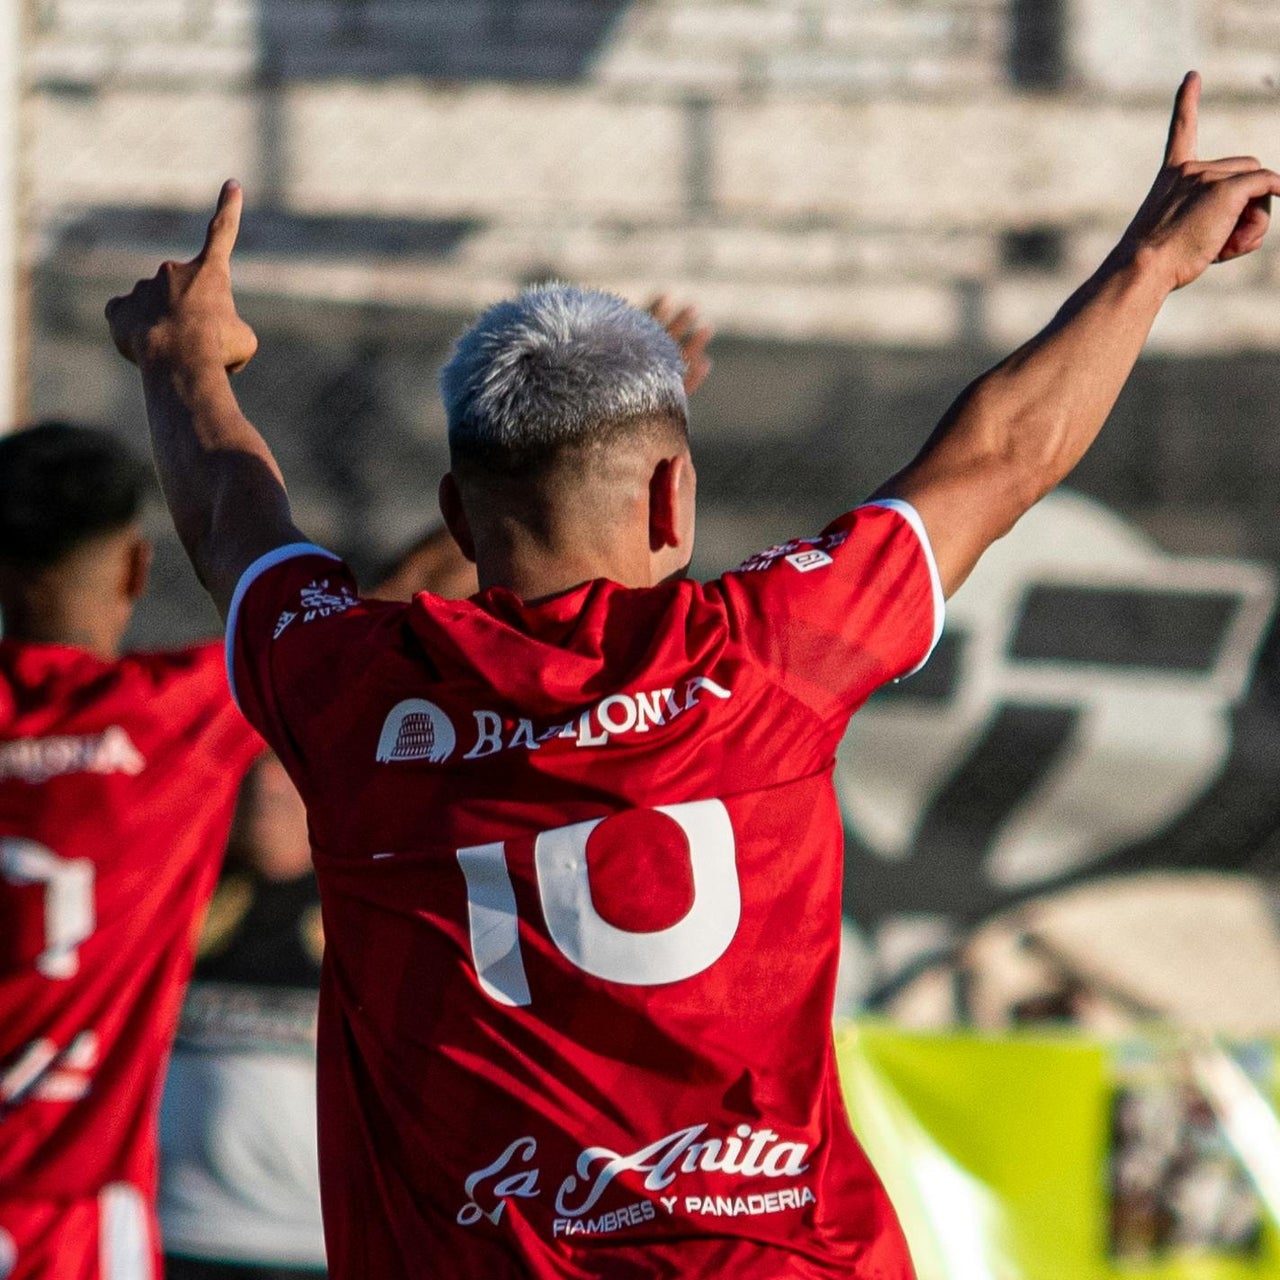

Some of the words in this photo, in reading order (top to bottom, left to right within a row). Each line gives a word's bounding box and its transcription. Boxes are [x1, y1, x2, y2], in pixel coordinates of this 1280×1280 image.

[456, 797, 742, 1008] 10
[456, 1135, 541, 1227] La
[554, 1122, 811, 1217] Anita
[552, 1199, 656, 1238] FIAMBRES
[659, 1195, 679, 1214] Y
[684, 1186, 817, 1217] PANADERIA
